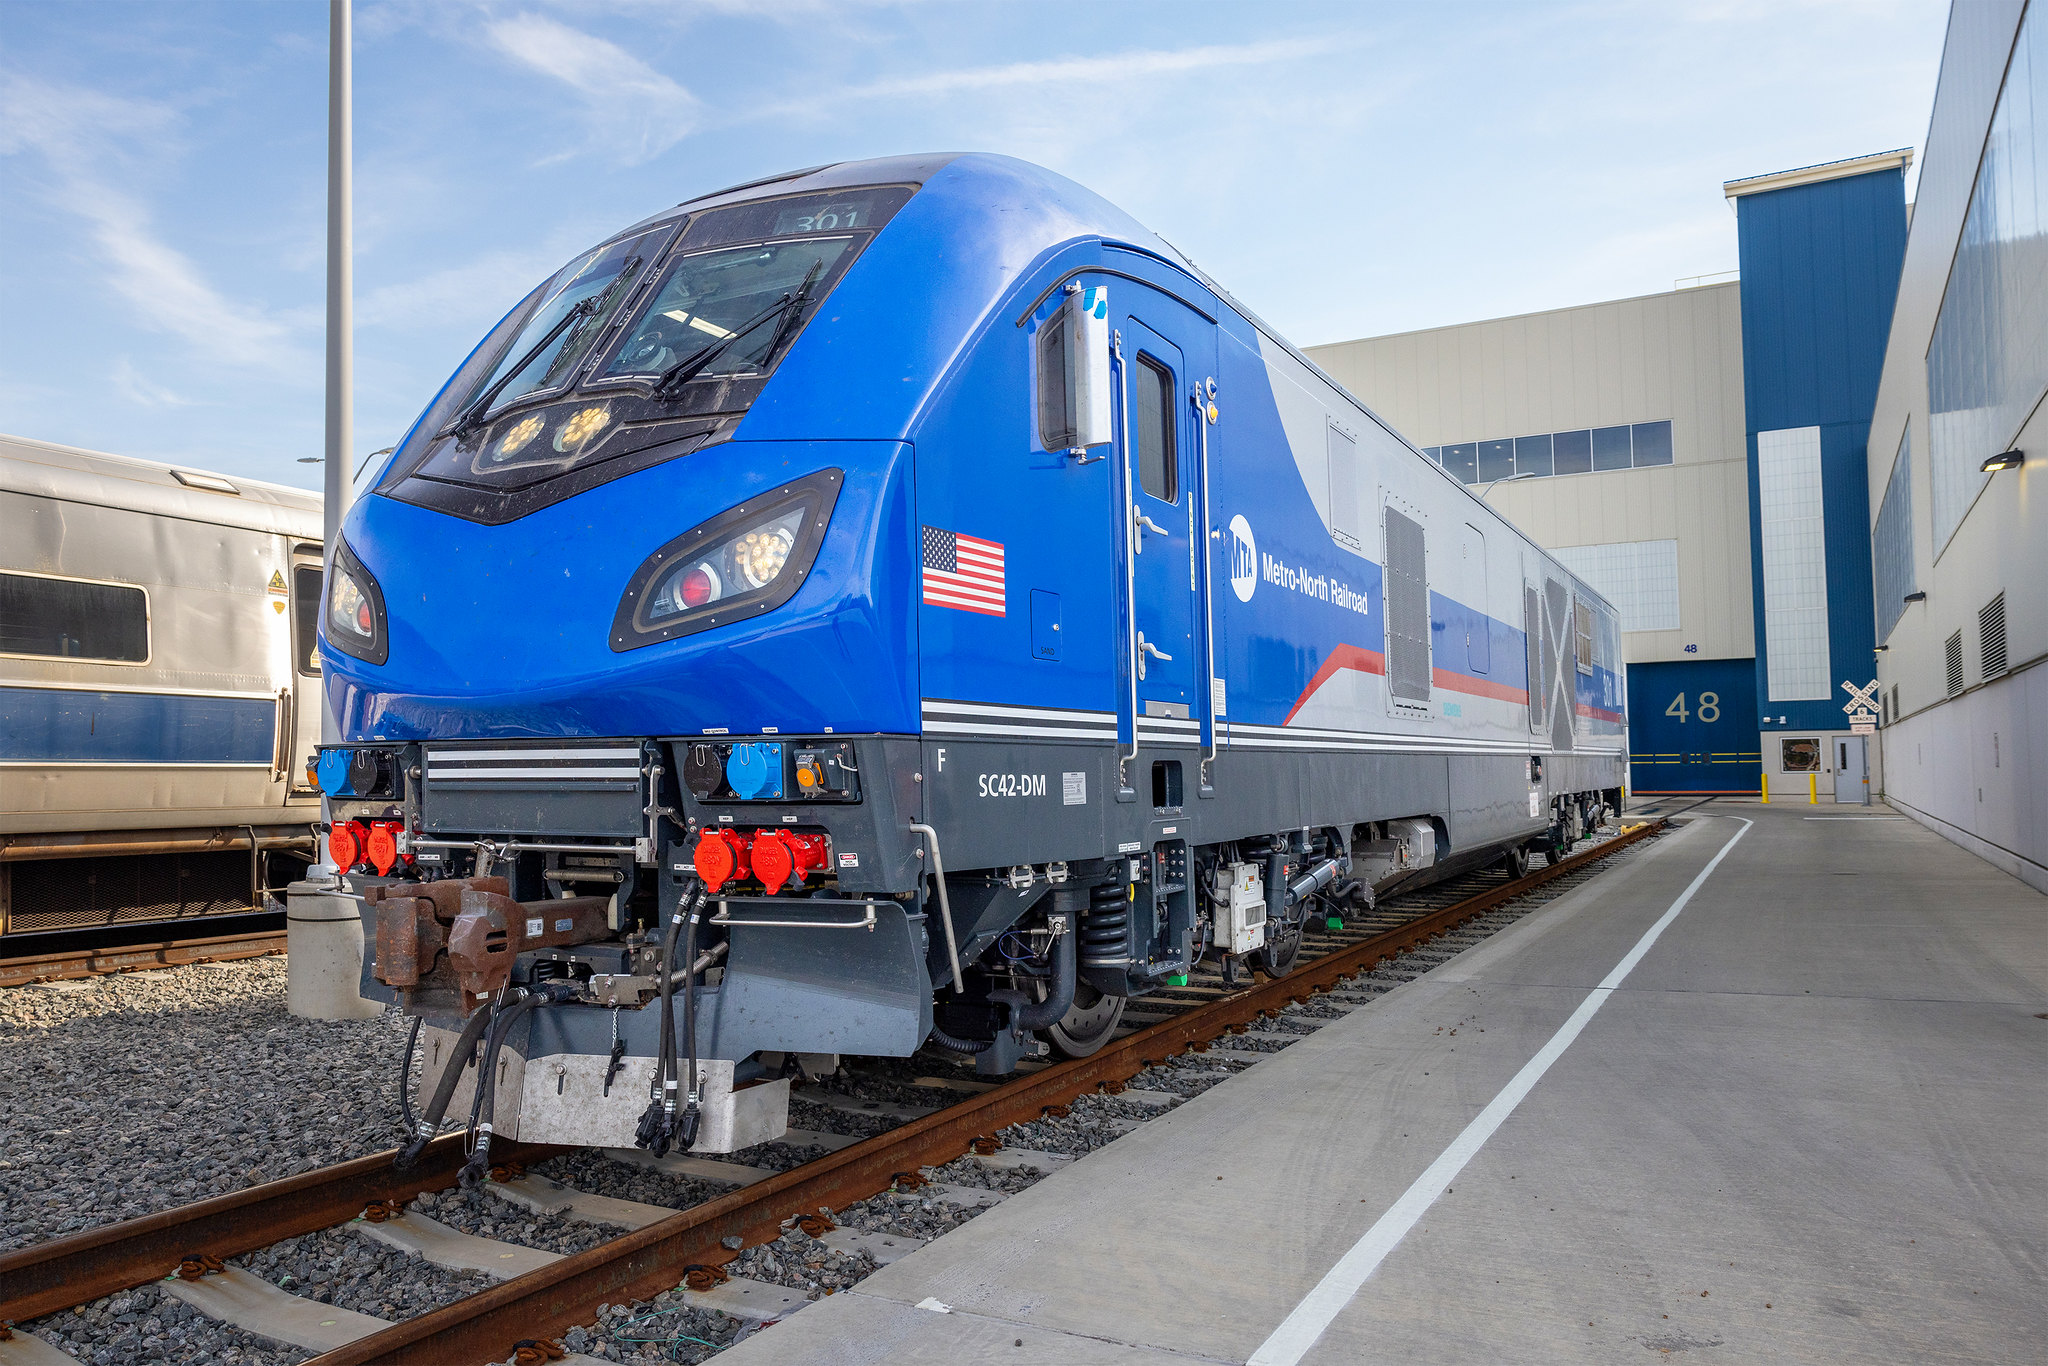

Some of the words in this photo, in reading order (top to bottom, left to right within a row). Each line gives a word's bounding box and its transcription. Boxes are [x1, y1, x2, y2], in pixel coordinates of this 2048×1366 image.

[797, 211, 858, 231] 301
[1262, 551, 1329, 602] Metro-North
[1330, 578, 1369, 616] Railroad
[1041, 646, 1055, 656] SAND
[1684, 644, 1698, 654] 48
[1665, 691, 1721, 724] 48
[1843, 681, 1860, 697] RAIL
[1864, 697, 1881, 712] ROAD
[1844, 680, 1880, 713] CROSSING
[937, 748, 946, 772] F
[978, 773, 1047, 798] SC42-DM
